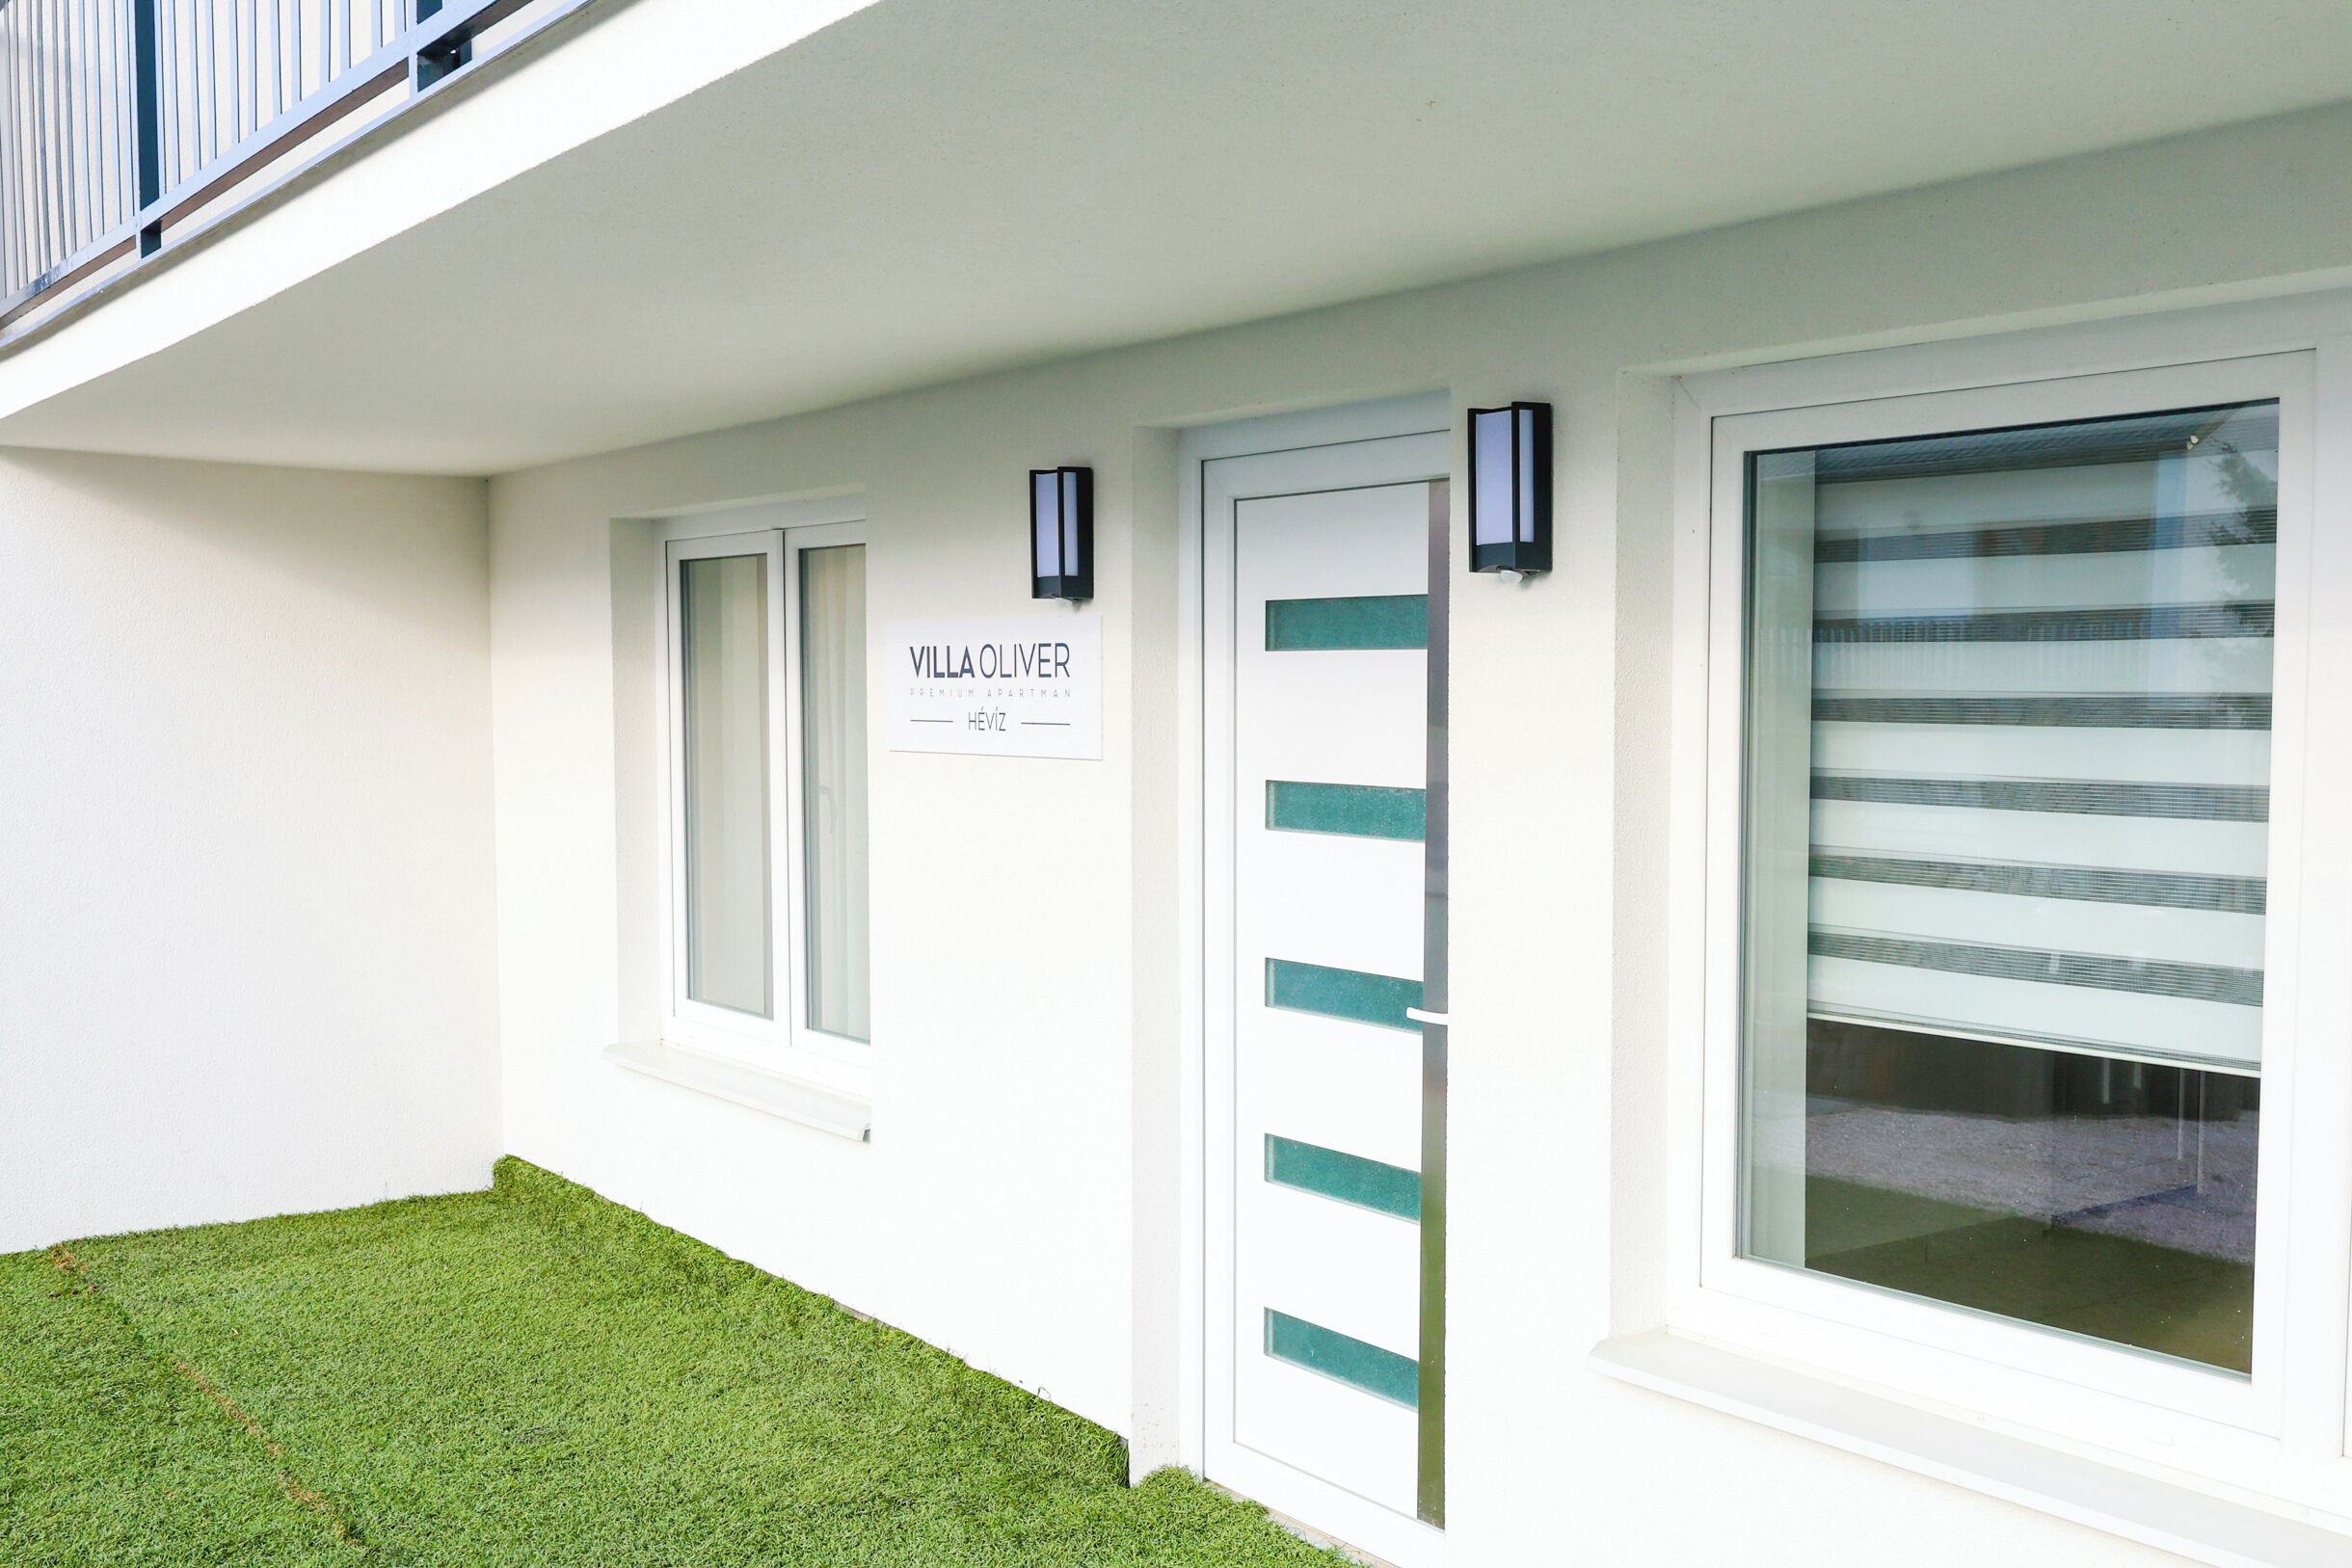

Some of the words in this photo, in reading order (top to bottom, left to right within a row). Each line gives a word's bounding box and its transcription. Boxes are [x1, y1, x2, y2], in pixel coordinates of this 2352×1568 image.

[910, 645, 976, 678] VILLA
[979, 642, 1071, 678] OLIVER
[987, 688, 1071, 698] APARTMAN
[968, 706, 1006, 731] HÉVÍZ
